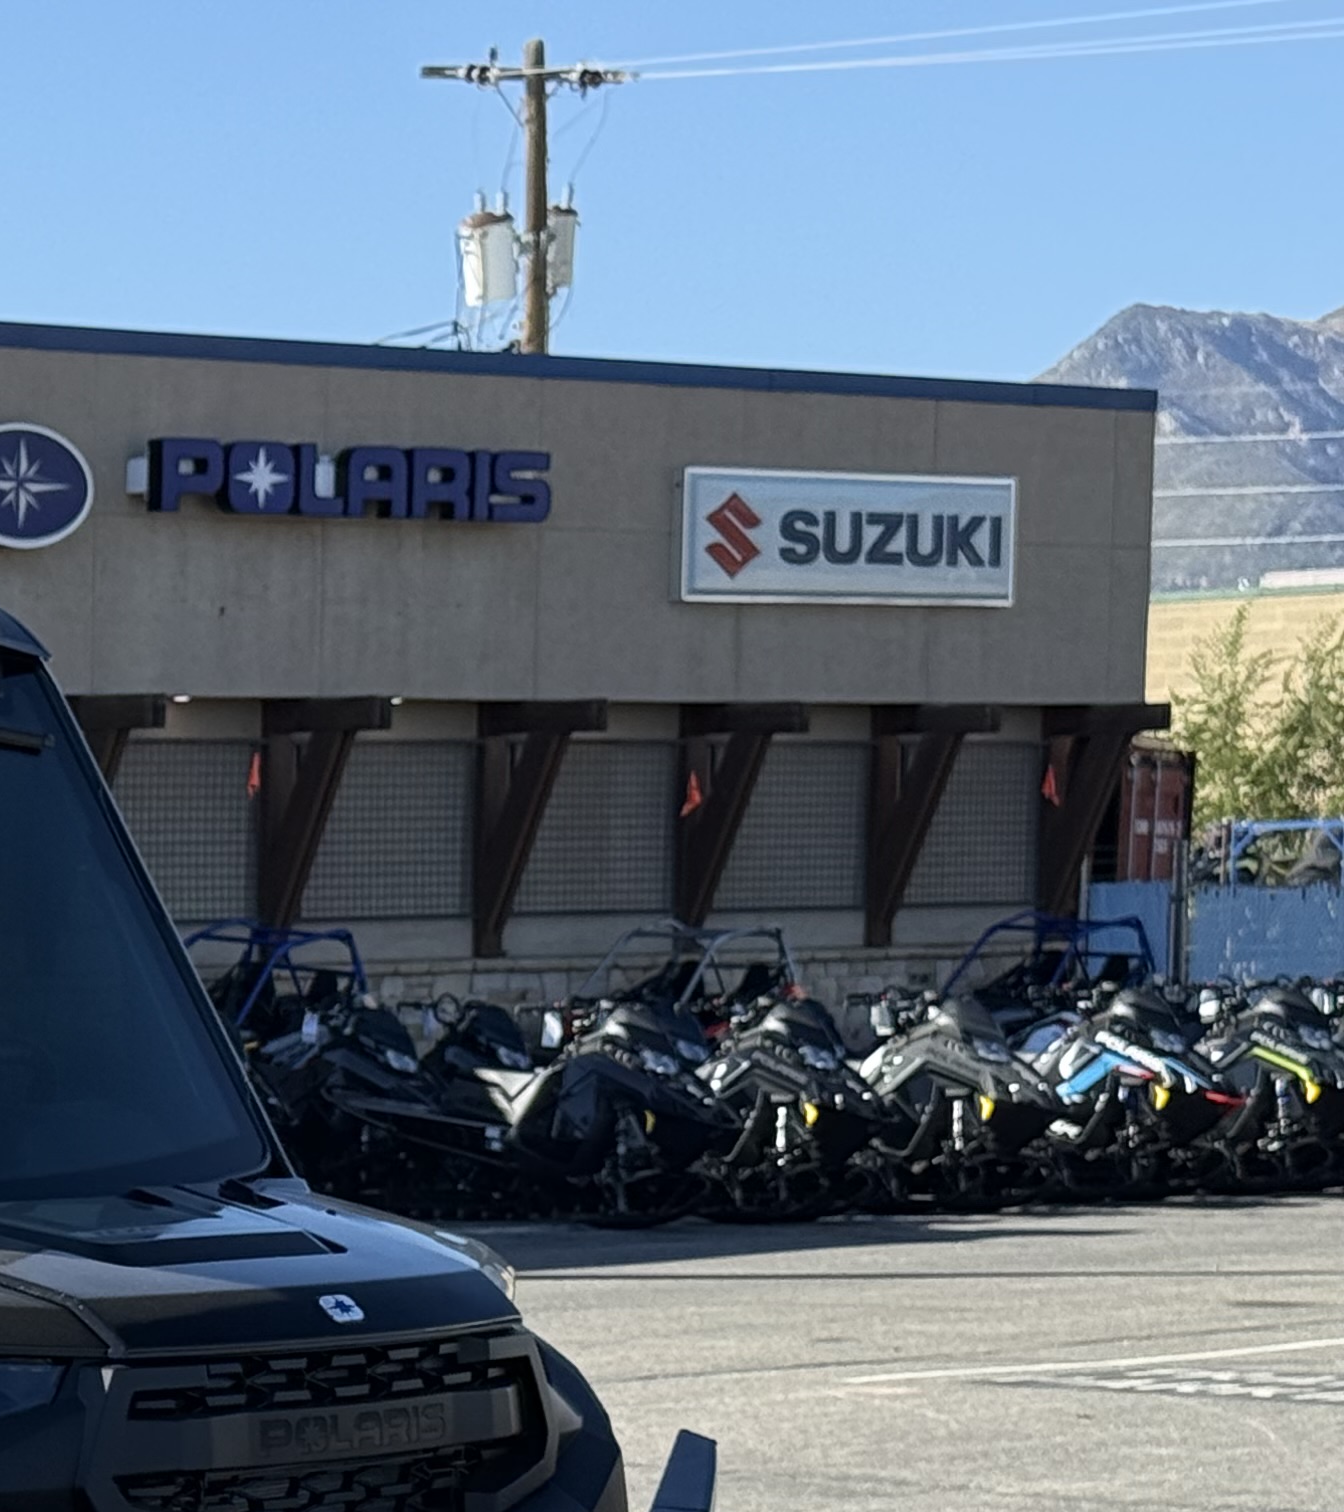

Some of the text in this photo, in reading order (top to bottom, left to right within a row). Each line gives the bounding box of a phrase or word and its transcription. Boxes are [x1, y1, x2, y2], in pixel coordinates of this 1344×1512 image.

[148, 438, 552, 523] POLARIS
[778, 509, 1003, 568] SUZUKI
[259, 1402, 447, 1455] POLARIS
